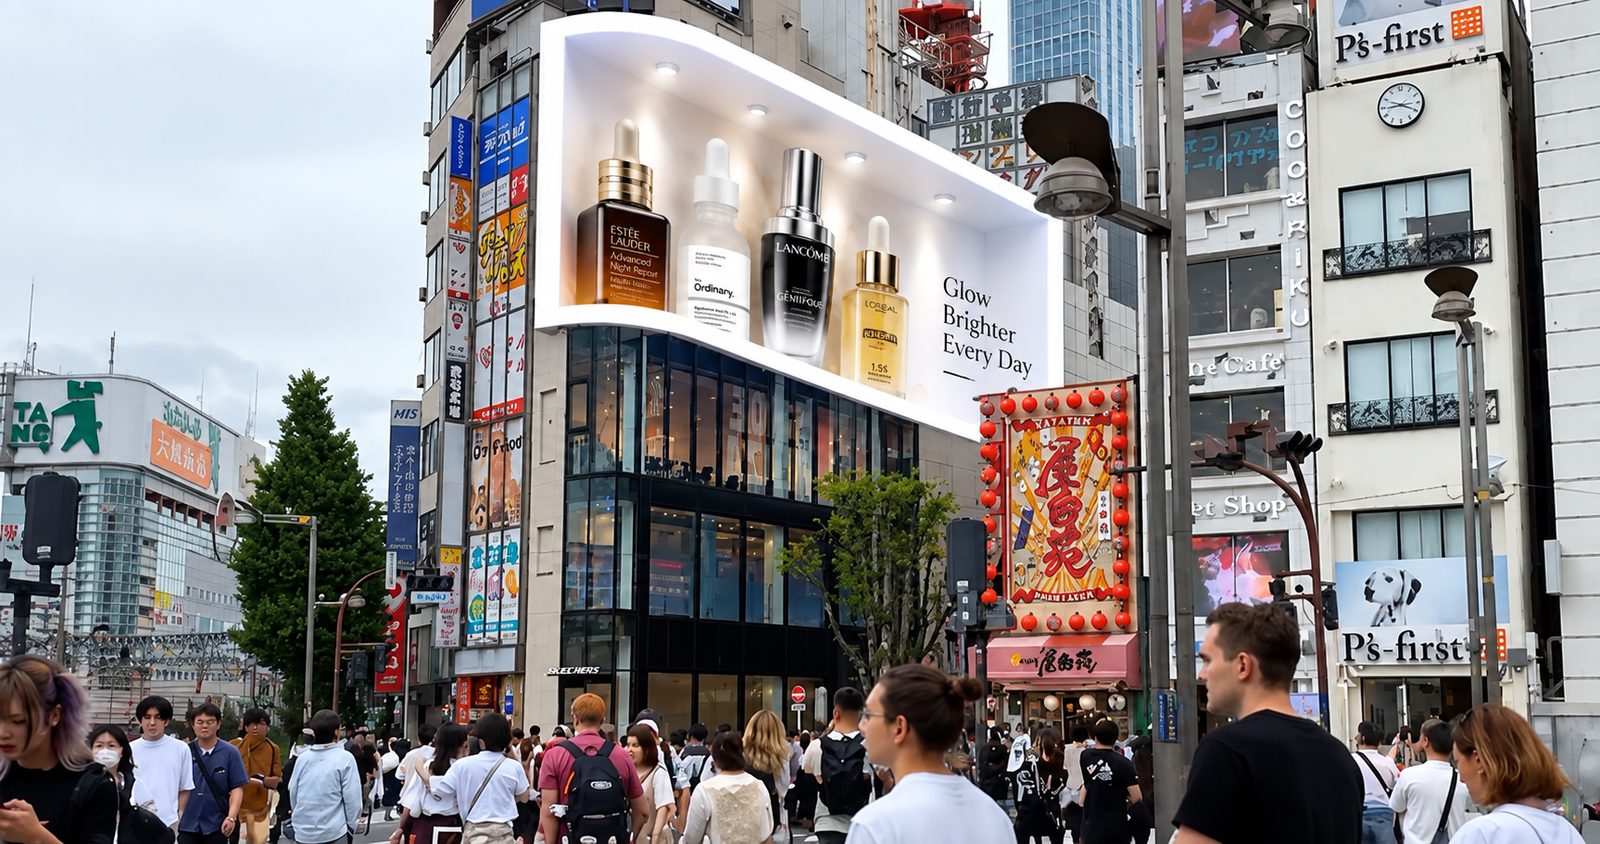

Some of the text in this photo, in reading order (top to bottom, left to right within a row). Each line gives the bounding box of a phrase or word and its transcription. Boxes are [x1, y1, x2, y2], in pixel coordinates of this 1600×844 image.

[1335, 23, 1444, 63] P's-first
[610, 235, 651, 252] LAUDER
[694, 282, 734, 299] Ordinary.
[943, 276, 991, 308] Glow
[943, 303, 1016, 344] Brighter
[943, 332, 1032, 380] Every Day
[394, 409, 418, 419] MIS
[1223, 495, 1286, 518] Shop
[1342, 630, 1463, 662] P's-first
[547, 666, 600, 675] SKECHERS
